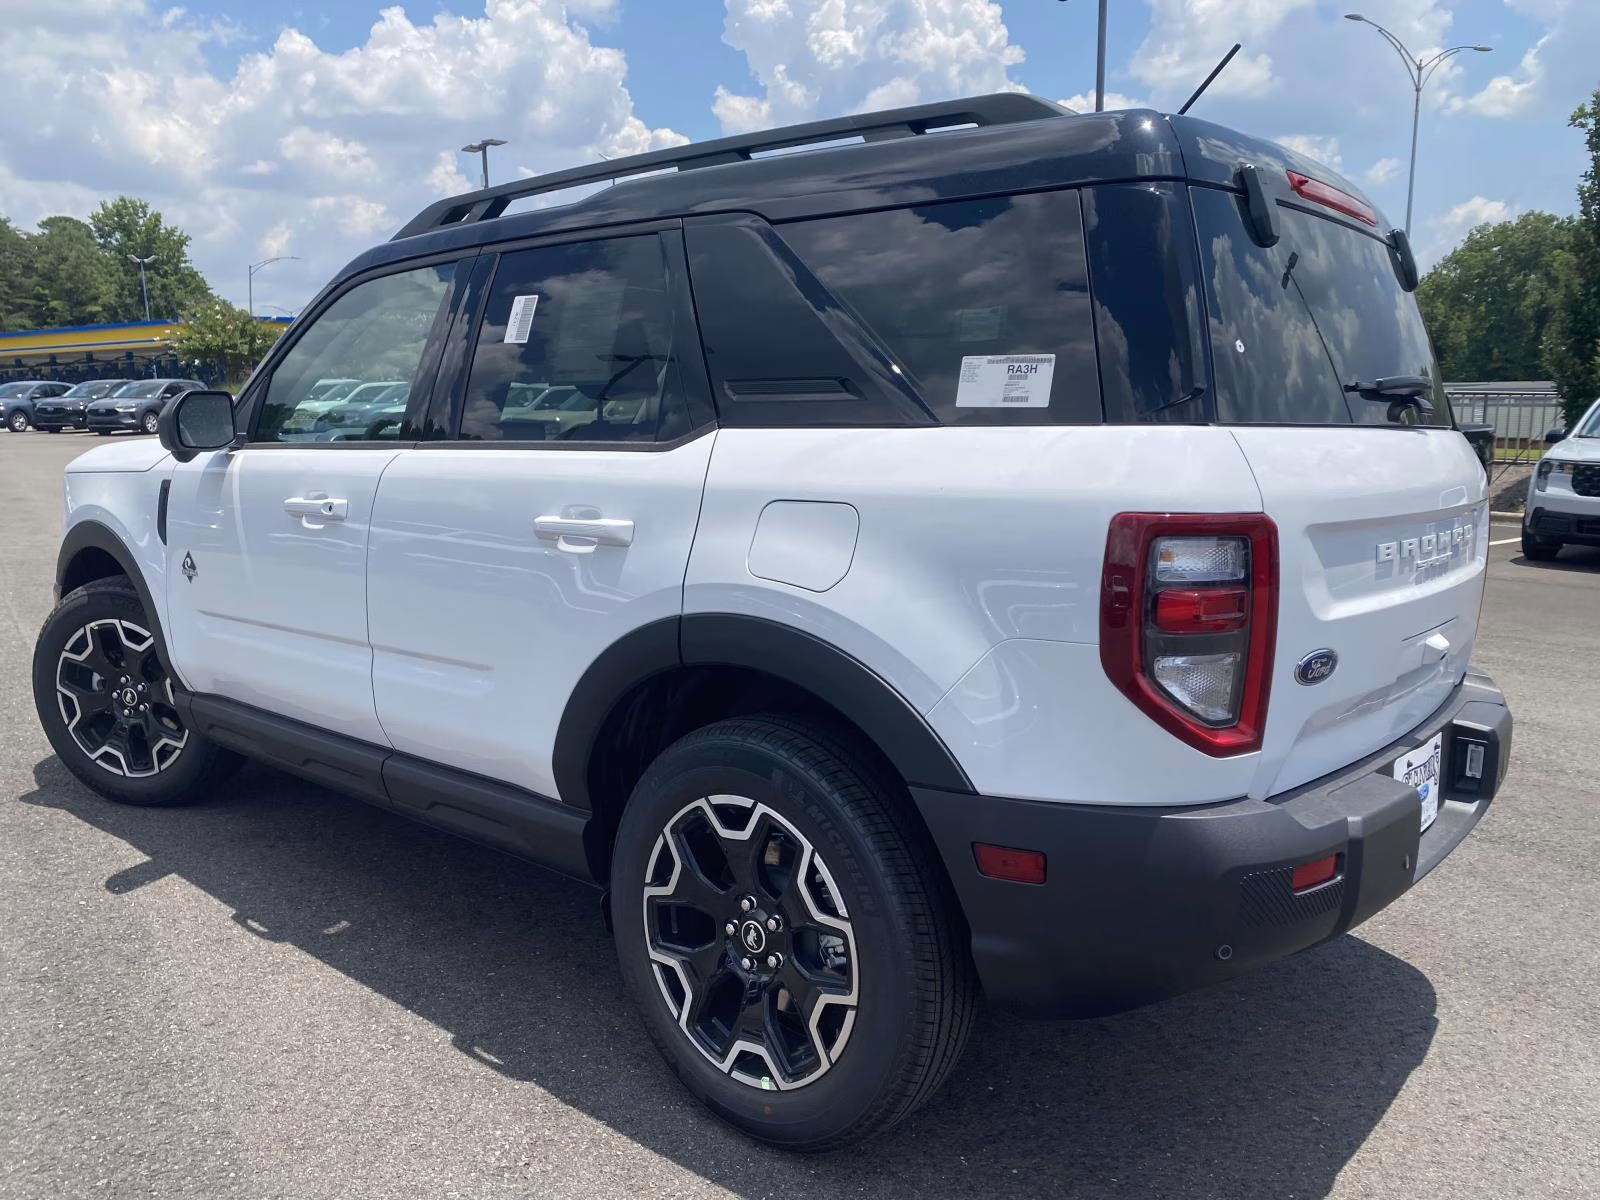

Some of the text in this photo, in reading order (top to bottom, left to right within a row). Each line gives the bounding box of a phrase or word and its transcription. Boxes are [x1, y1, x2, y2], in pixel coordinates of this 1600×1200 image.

[1007, 364, 1038, 374] RA3H
[1376, 524, 1473, 563] BRONCO
[804, 803, 876, 913] MICHELIN
